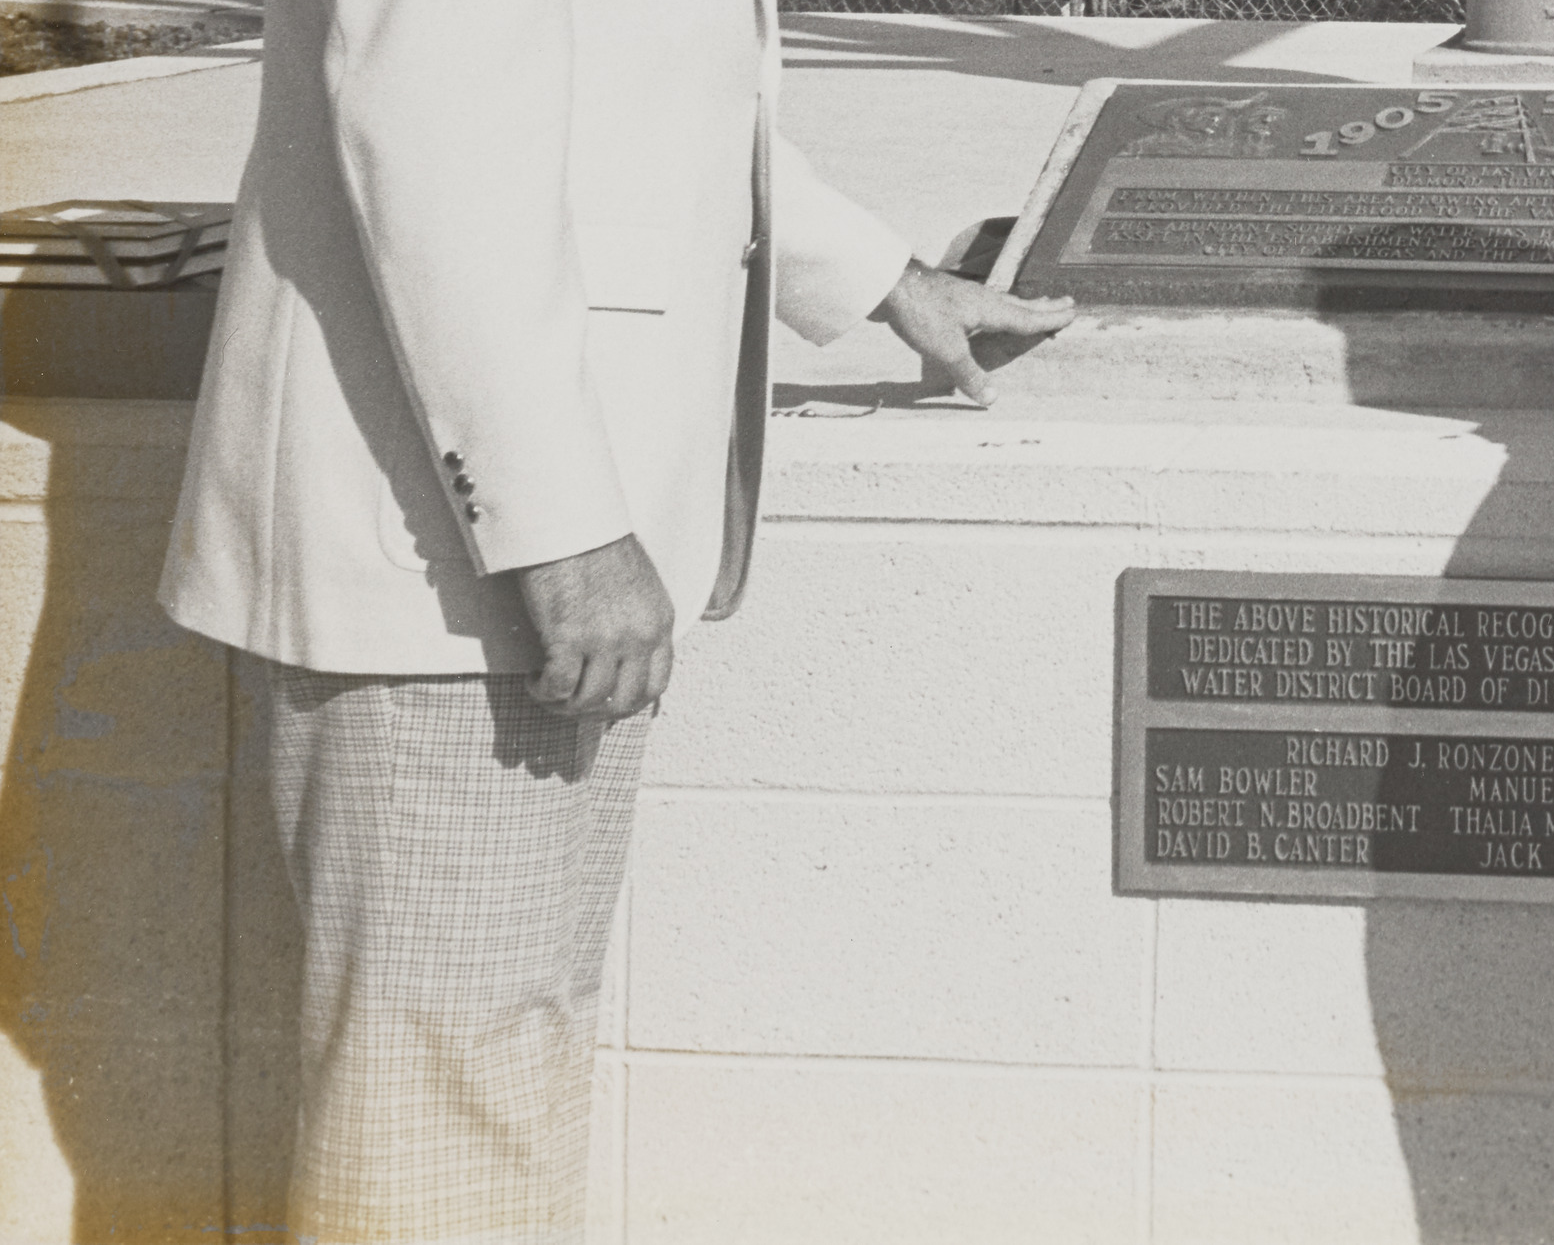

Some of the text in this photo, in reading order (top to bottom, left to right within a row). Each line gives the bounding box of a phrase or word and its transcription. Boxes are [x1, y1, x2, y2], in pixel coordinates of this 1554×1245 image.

[1300, 91, 1459, 155] 1905
[1392, 176, 1483, 187] DIAMOND
[1446, 166, 1471, 177] OF
[1481, 166, 1515, 177] LAS
[1119, 190, 1178, 202] FROM
[1192, 191, 1272, 203] WITHIN
[1289, 192, 1333, 204] THIS
[1345, 194, 1395, 205] AREA
[1406, 195, 1499, 206] FLOWING
[1134, 202, 1242, 213] PROVIDED
[1257, 203, 1293, 214] THE
[1436, 206, 1461, 217] TO
[1475, 206, 1516, 218] THE
[1107, 231, 1169, 242] ASSET
[1185, 232, 1205, 243] IN
[1220, 233, 1254, 244] THE
[1109, 220, 1153, 230] THIS
[1165, 221, 1272, 233] ABUNDANT
[1287, 222, 1355, 235] SUPPLY
[1370, 225, 1393, 236] OF
[1409, 225, 1475, 237] WATER
[1488, 227, 1527, 238] HAS
[1262, 245, 1285, 256] OF
[1301, 246, 1335, 257] LAS
[1351, 248, 1414, 260] VEGAS
[1428, 250, 1465, 261] AND
[1482, 251, 1516, 262] THE
[1174, 602, 1222, 630] THE
[1234, 604, 1315, 633] ABOVE
[1328, 607, 1464, 638] HISTORICAL
[1189, 634, 1314, 666] DEDICATED
[1326, 638, 1353, 667] BY
[1369, 639, 1416, 668] THE
[1430, 642, 1470, 671] LAS
[1181, 668, 1263, 696] WATER
[1276, 669, 1376, 700] DISTRICT
[1391, 674, 1466, 703] BOARD
[1481, 677, 1509, 704] OF
[1286, 736, 1554, 772] RICHARD J. RONZONE
[1156, 765, 1318, 797] SAM BOWLER
[1158, 798, 1246, 827] ROBERT
[1450, 807, 1533, 837] THALIA
[1157, 830, 1230, 859] DAVID
[1274, 833, 1370, 864] CANTER
[1480, 842, 1542, 869] JACK
